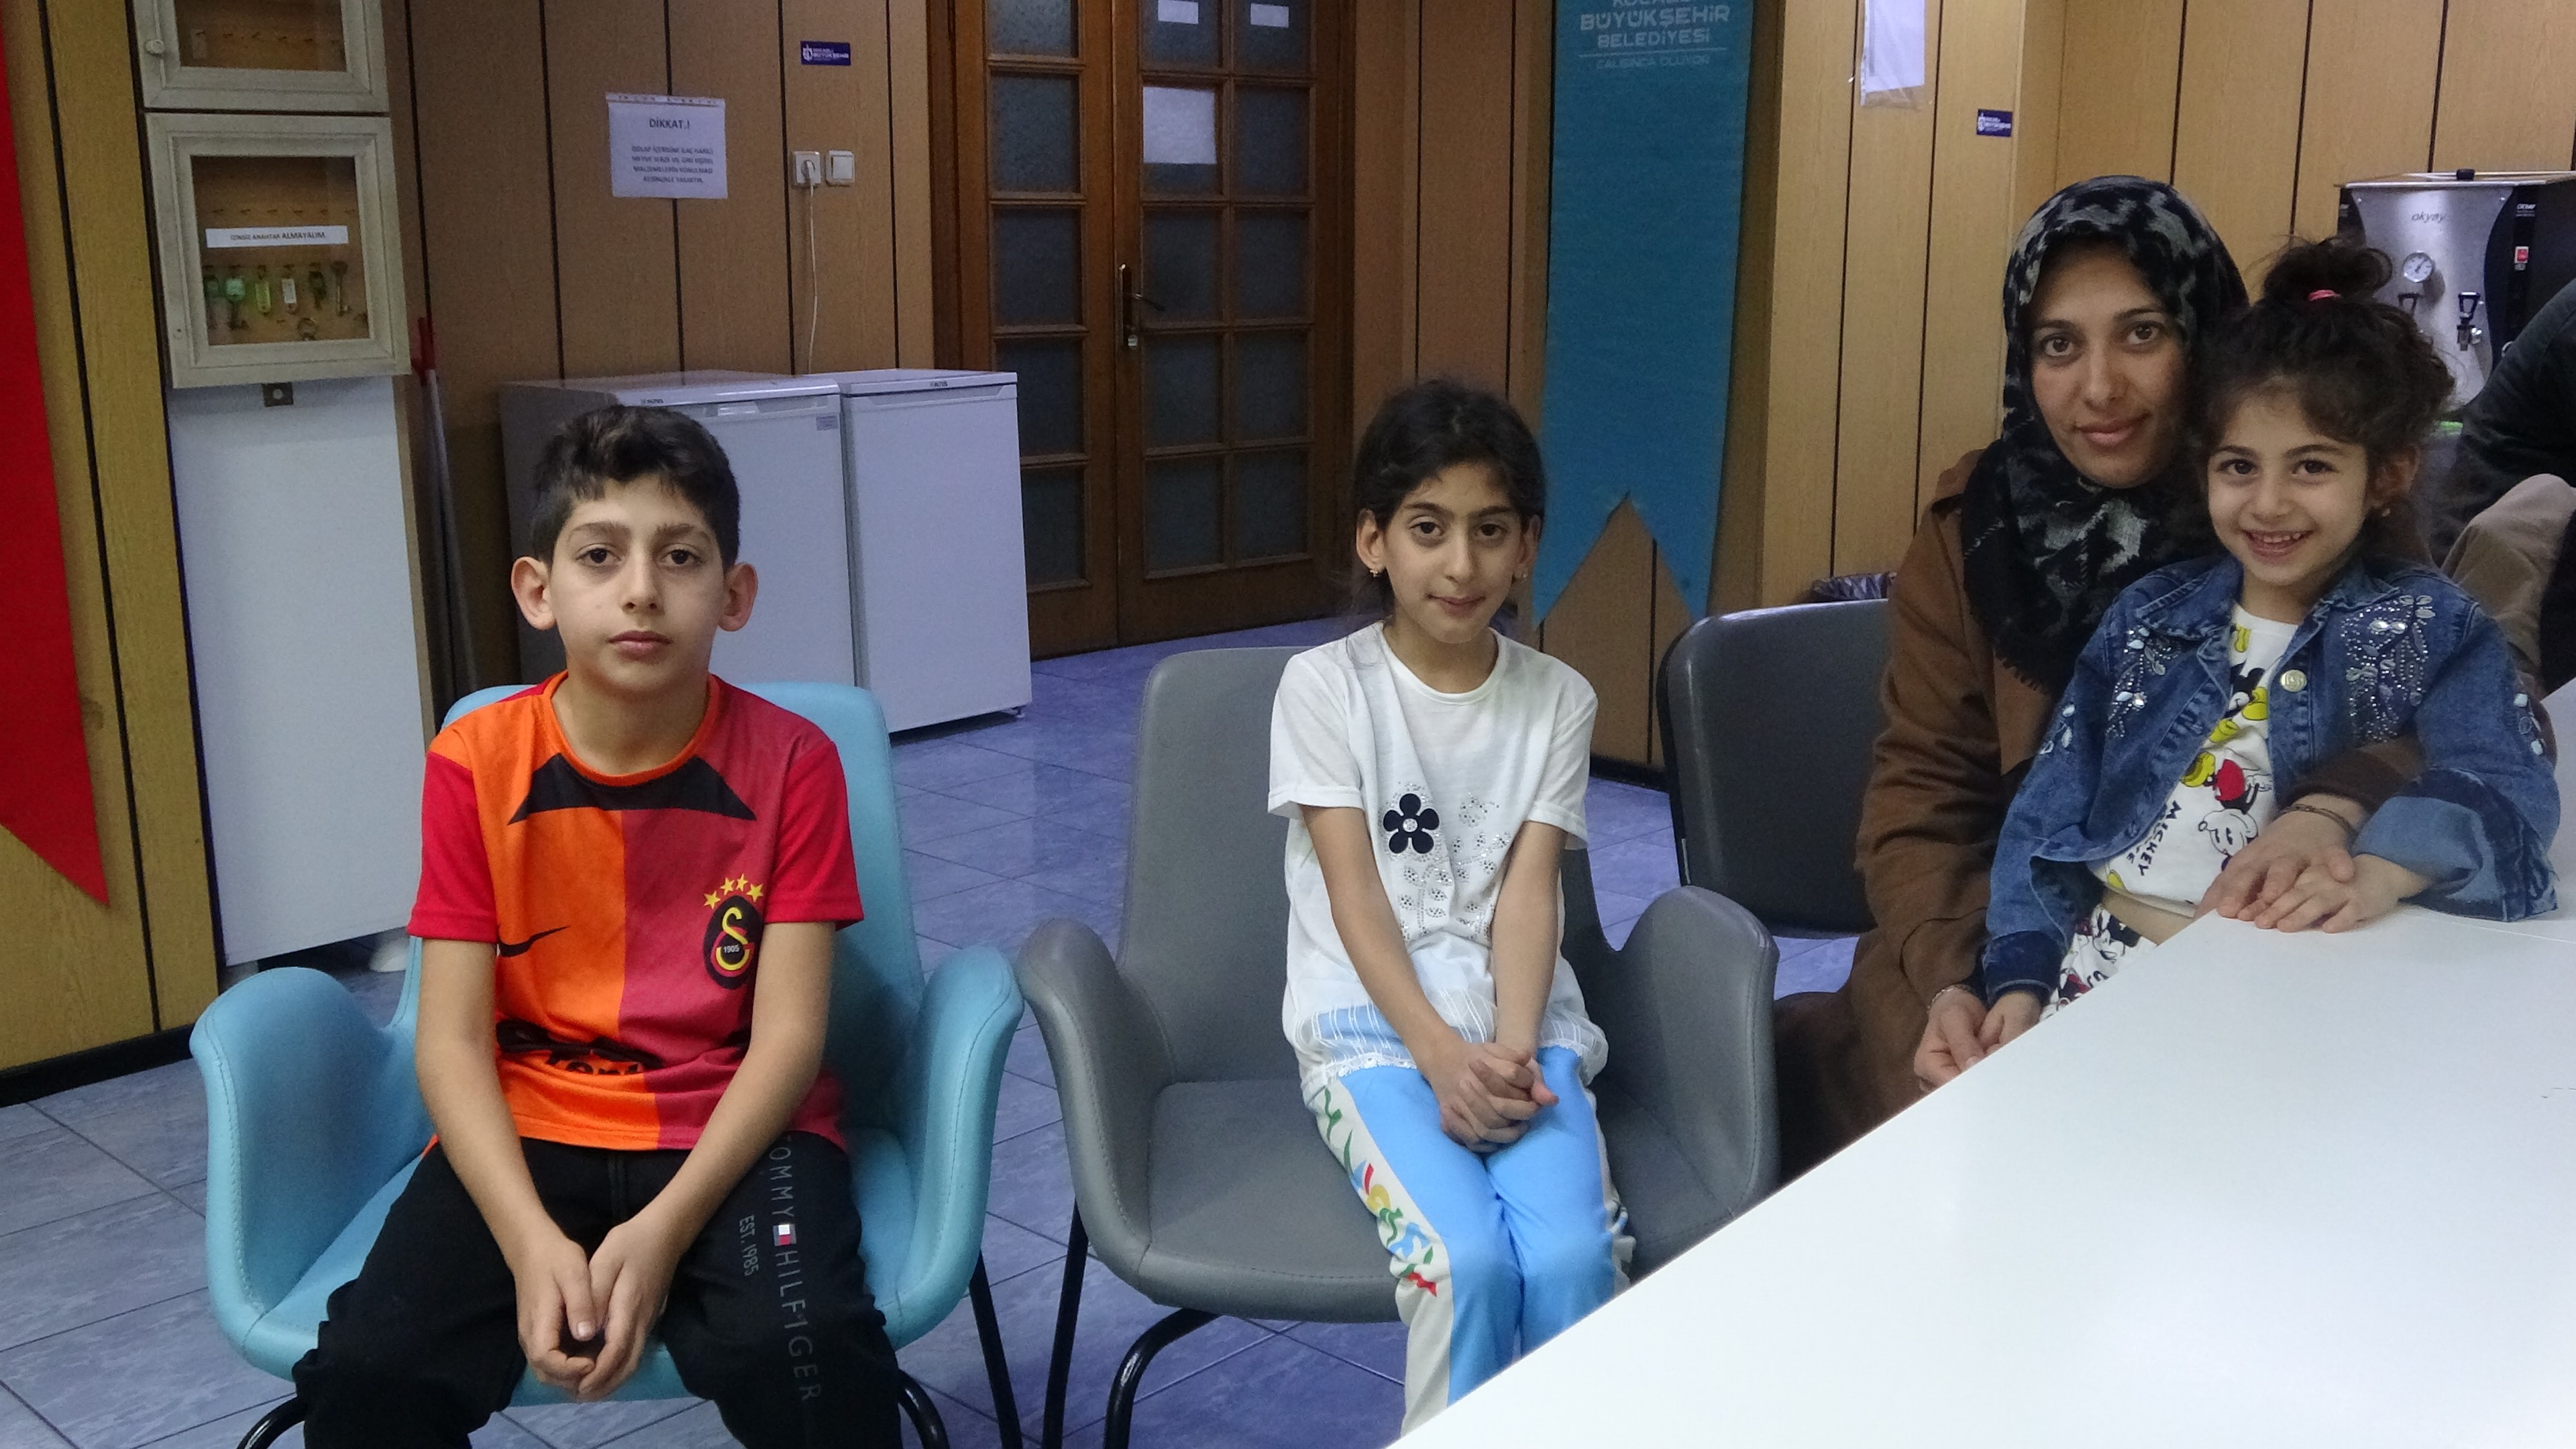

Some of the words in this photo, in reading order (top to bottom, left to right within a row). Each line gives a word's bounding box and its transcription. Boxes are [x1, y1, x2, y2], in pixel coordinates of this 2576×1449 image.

[1580, 5, 1730, 30] BÜYÜKŞEHİR
[1598, 28, 1710, 48] BELEDİYESİ
[2138, 800, 2182, 876] MICKEY
[723, 945, 740, 953] 1905
[739, 1214, 755, 1244] EST.
[742, 1243, 759, 1277] 1985
[775, 1250, 823, 1401] HILFIGER
